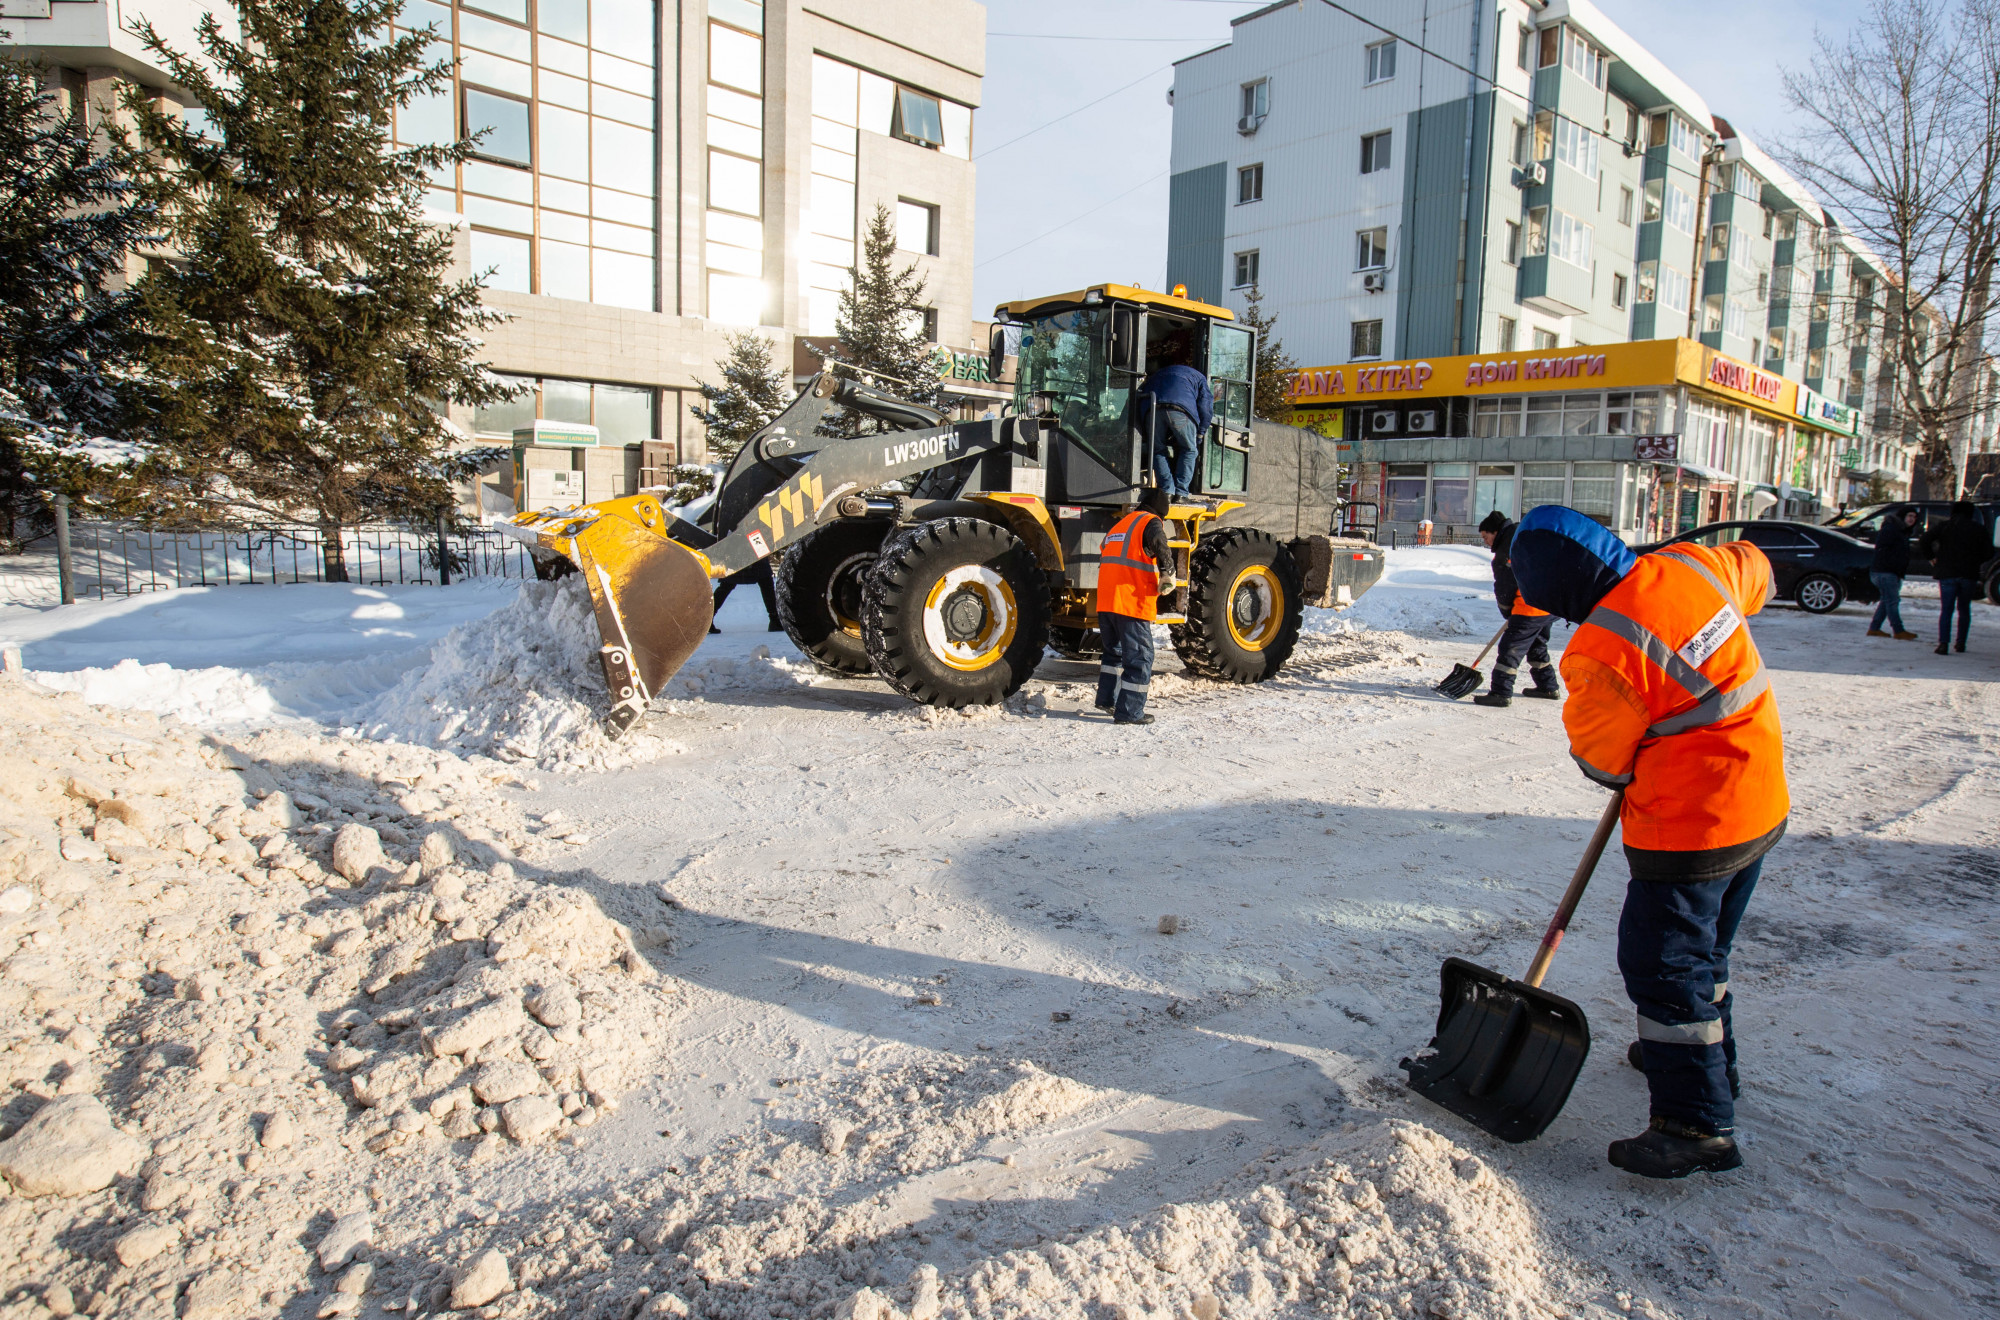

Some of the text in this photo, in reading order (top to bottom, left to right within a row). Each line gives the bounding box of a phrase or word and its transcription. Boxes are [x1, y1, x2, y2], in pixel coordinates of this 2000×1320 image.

[953, 366, 999, 383] BAN
[954, 352, 1005, 373] HAL
[1465, 355, 1606, 386] ДОМ КНИГИ
[1286, 364, 1432, 396] TANA KITAP
[1708, 356, 1781, 403] ASTANA KITAP
[1287, 413, 1337, 425] родам
[885, 432, 959, 466] LW300FN
